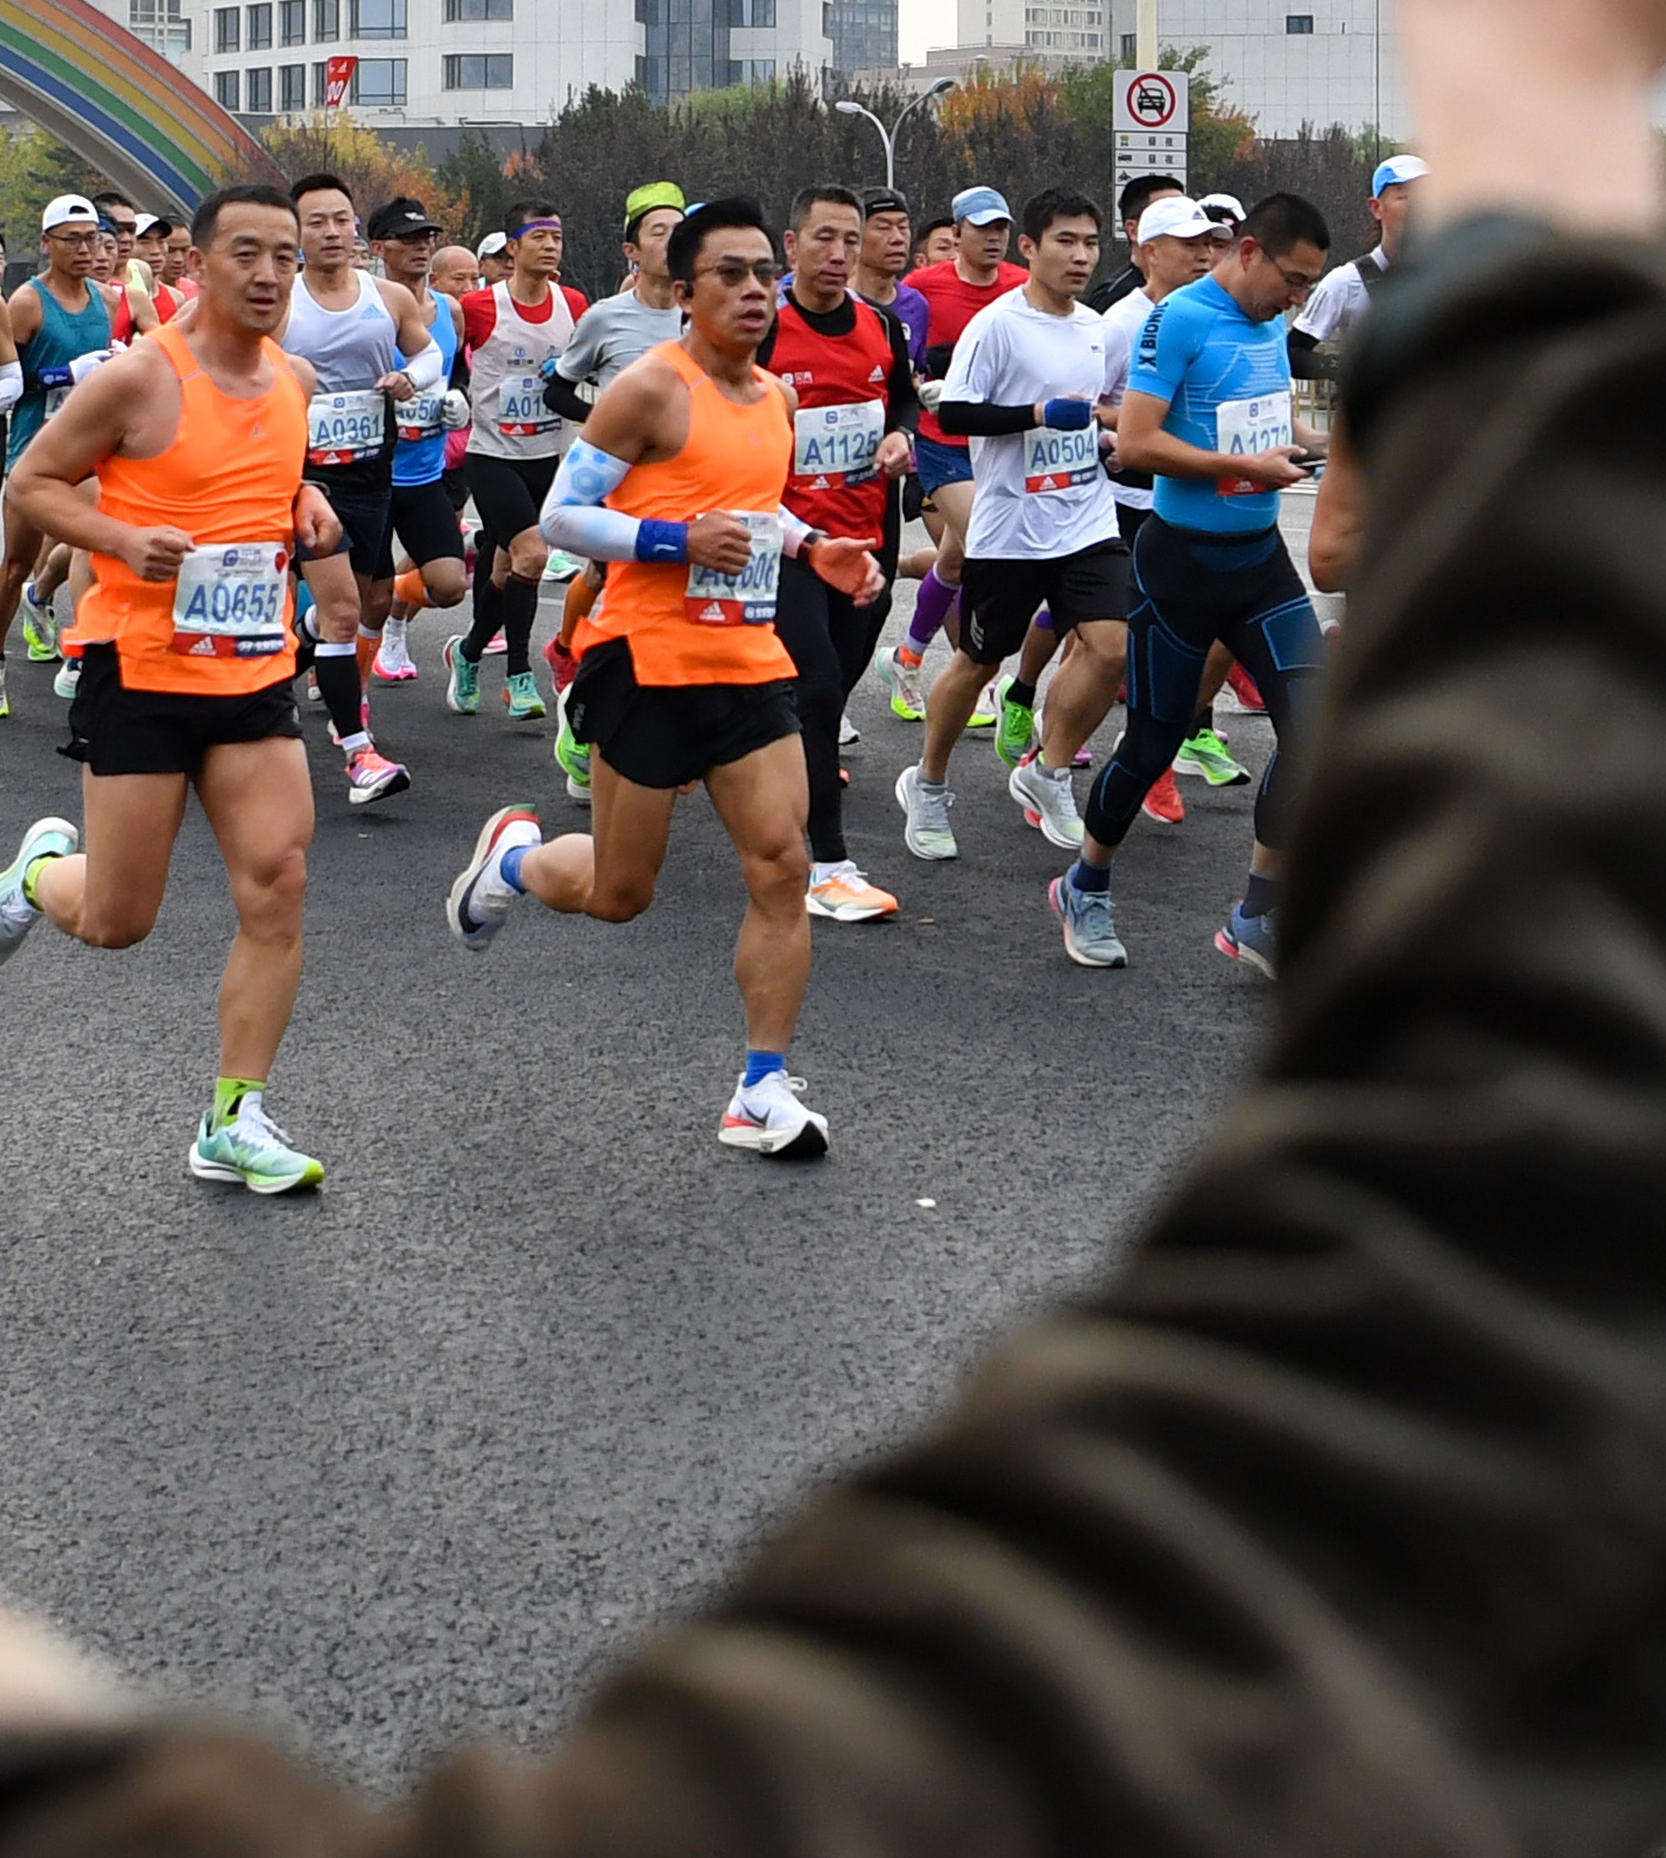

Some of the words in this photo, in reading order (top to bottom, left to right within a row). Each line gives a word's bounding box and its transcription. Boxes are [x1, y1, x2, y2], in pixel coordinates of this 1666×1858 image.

[315, 413, 381, 445] A0361
[802, 429, 878, 466] A1125
[1030, 431, 1095, 469] A0504
[183, 583, 280, 624] A0655
